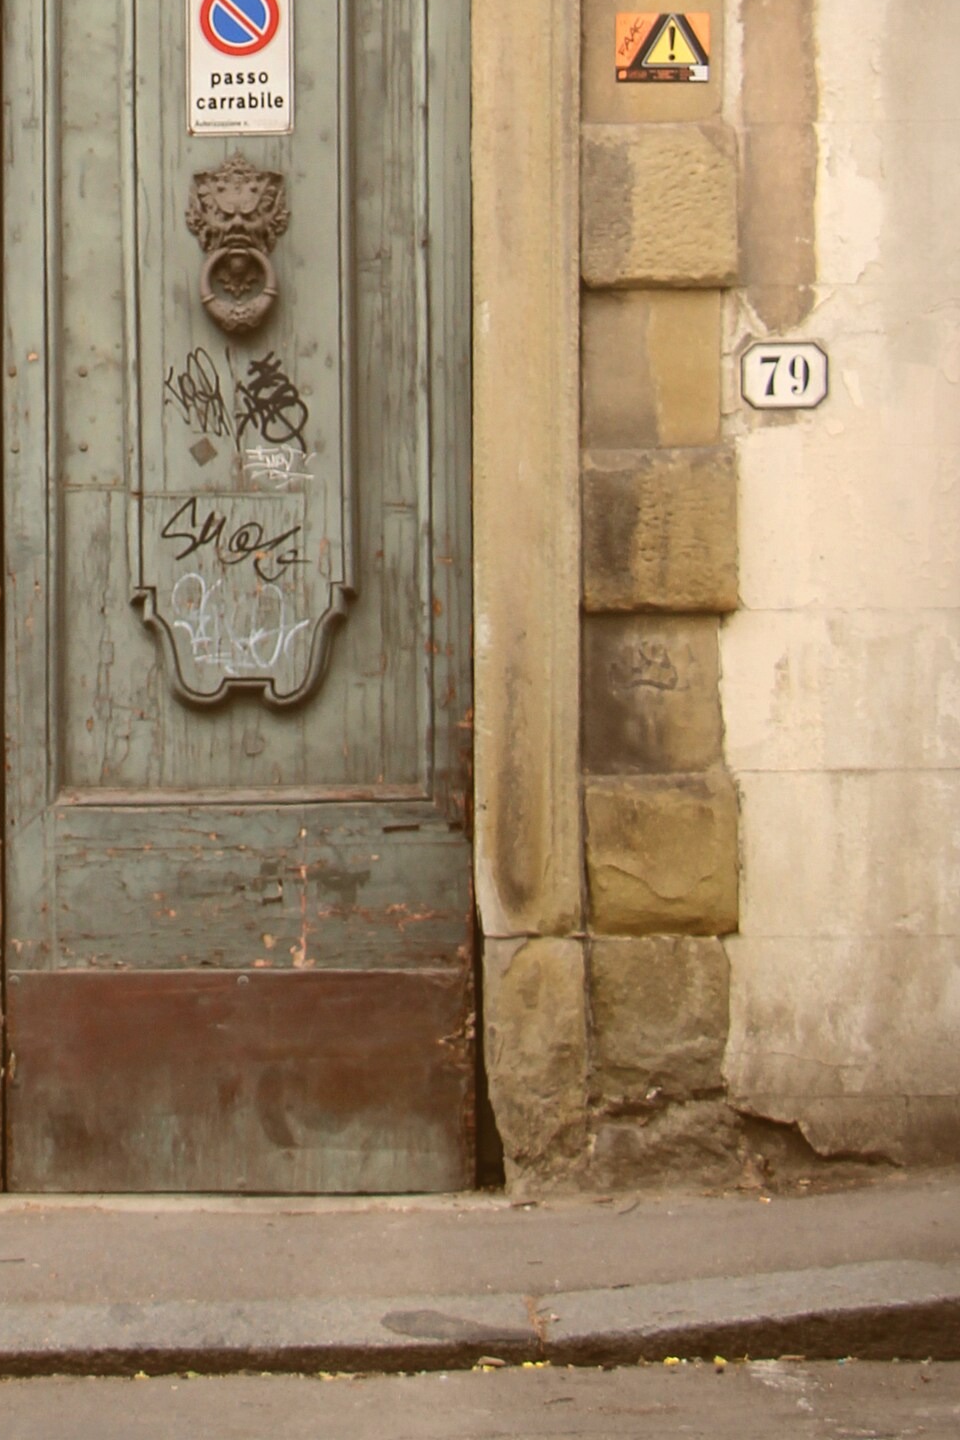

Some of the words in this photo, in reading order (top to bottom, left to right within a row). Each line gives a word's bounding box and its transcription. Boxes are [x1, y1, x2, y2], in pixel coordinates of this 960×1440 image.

[210, 71, 269, 88] passo
[196, 91, 284, 110] carrabile
[759, 354, 810, 397] 79
